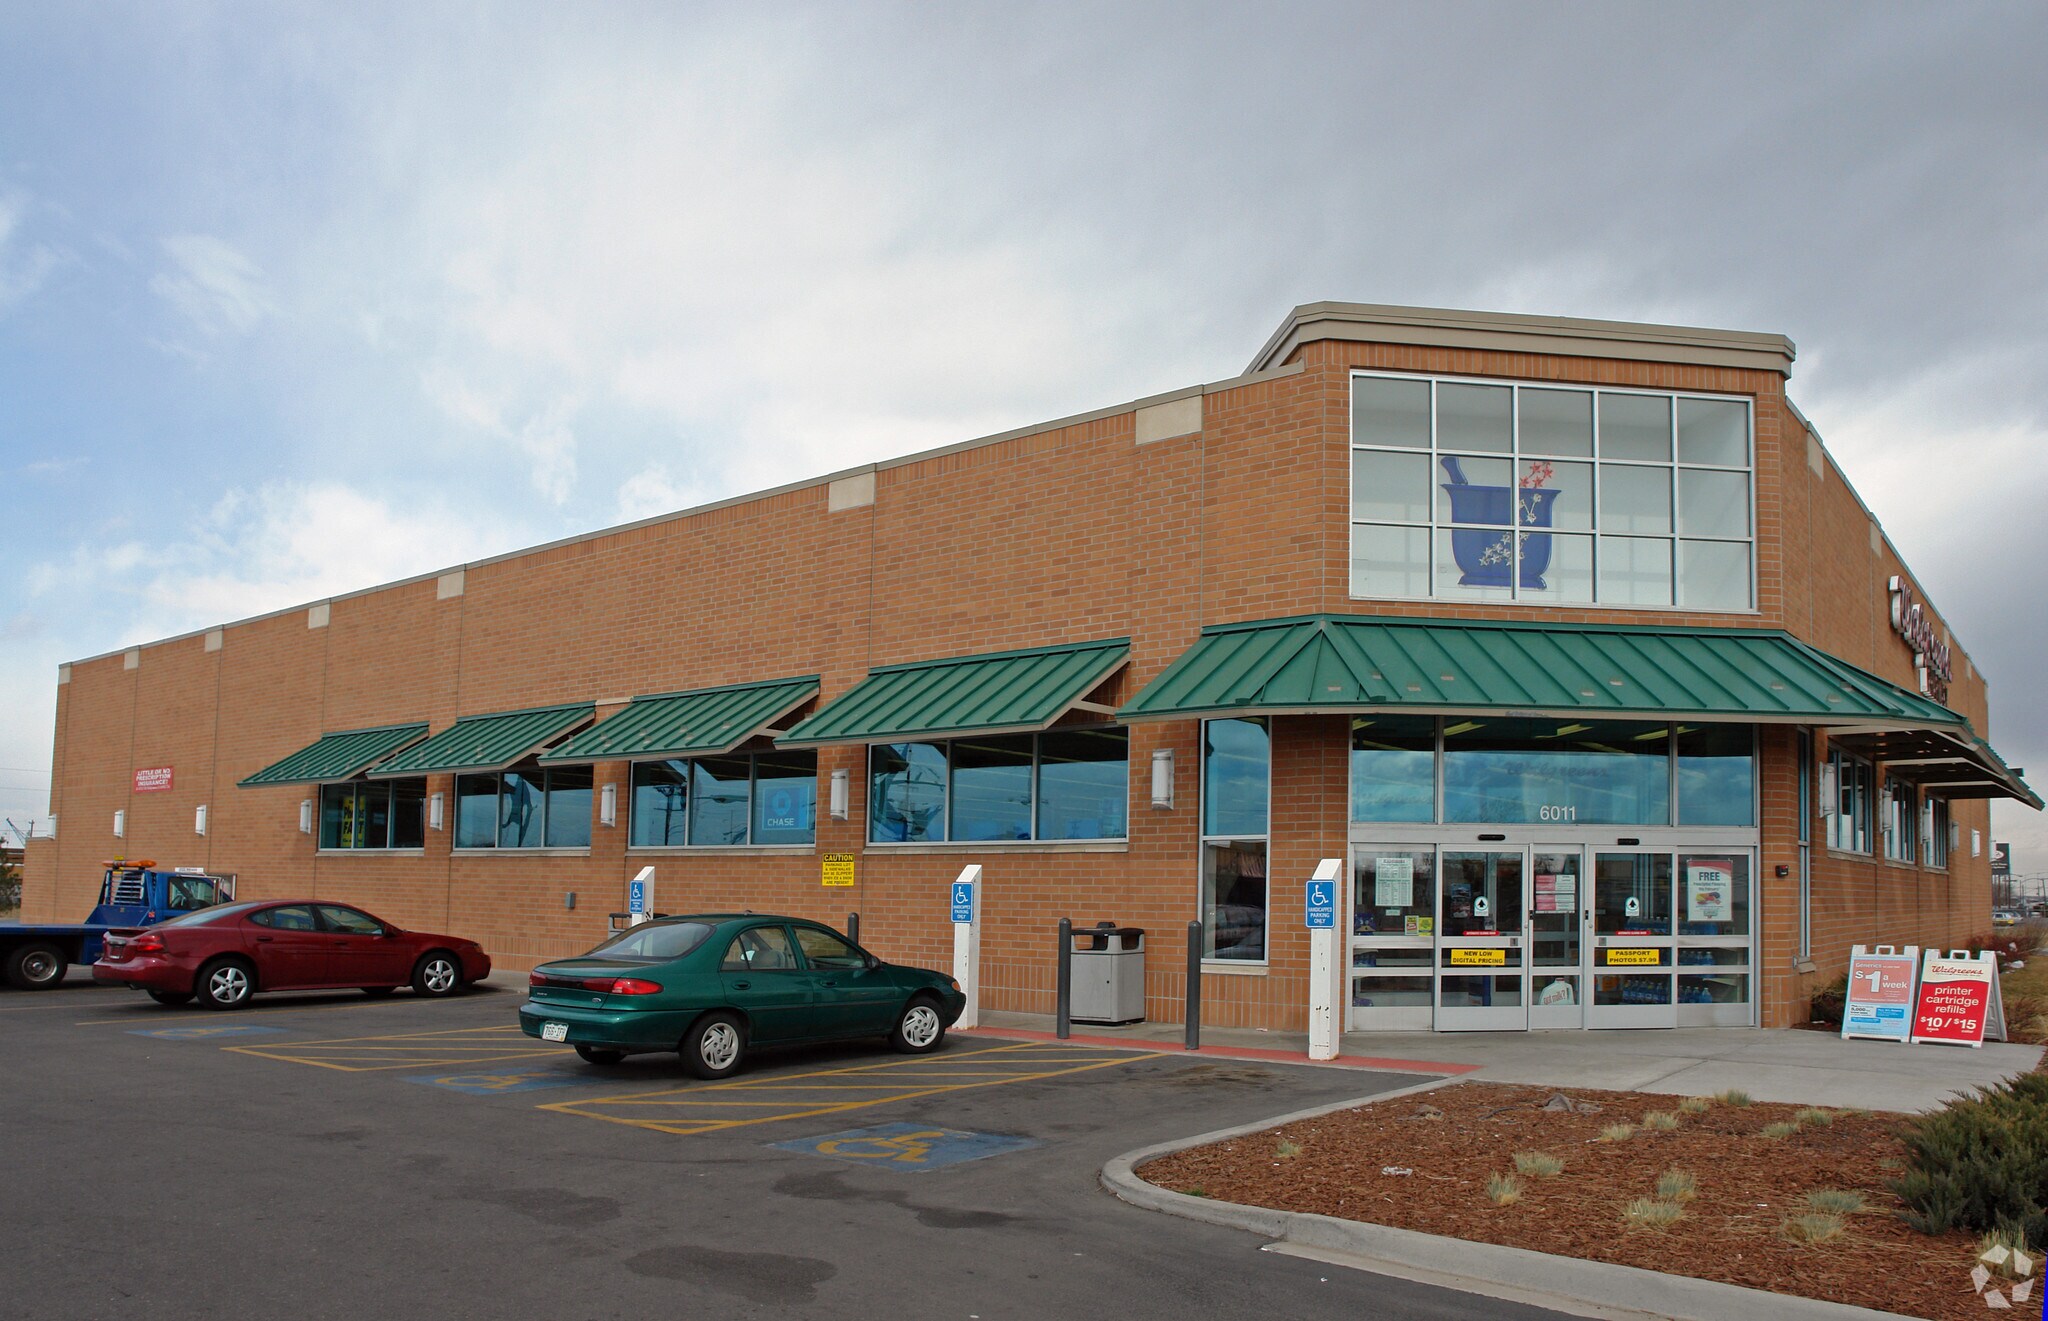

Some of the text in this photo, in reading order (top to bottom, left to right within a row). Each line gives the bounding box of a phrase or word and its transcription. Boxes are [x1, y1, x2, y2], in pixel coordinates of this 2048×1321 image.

[1540, 806, 1576, 820] 6011
[768, 818, 795, 826] CHASE
[343, 821, 364, 834] FAT
[1698, 872, 1720, 881] FREE
[1932, 966, 1983, 976] Walgreens
[1855, 970, 1881, 992] $1
[1935, 986, 1973, 995] printer
[1926, 996, 1979, 1007] cartridge
[1935, 1005, 1966, 1014] refills
[1920, 1016, 1976, 1029] $10 / $15
